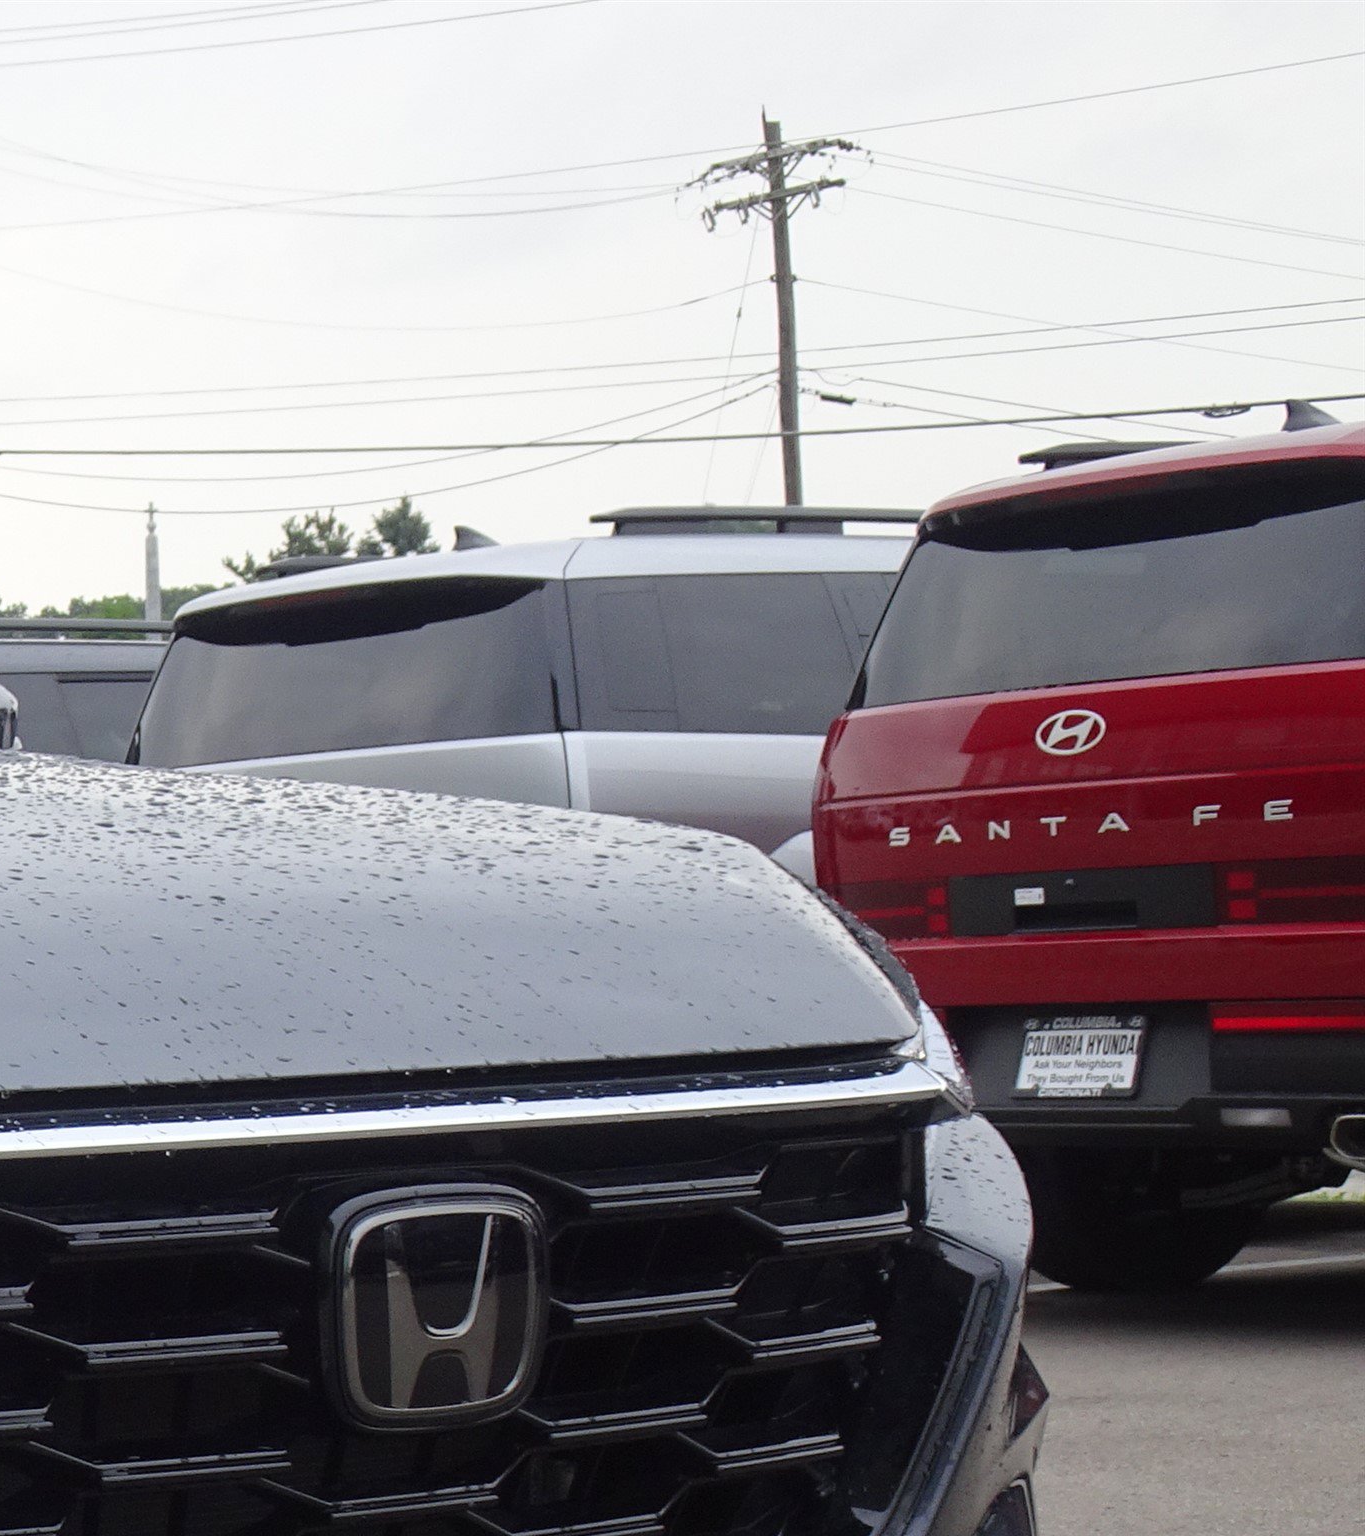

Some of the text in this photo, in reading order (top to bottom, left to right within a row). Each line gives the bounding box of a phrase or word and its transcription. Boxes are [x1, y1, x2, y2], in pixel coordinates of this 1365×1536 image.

[888, 799, 1294, 847] SANTA FE
[1052, 1015, 1116, 1030] COLUMBIA
[1024, 1033, 1137, 1056] COLUMBIA HYUNDA
[1033, 1059, 1123, 1071] Ask Your Neighbors
[1027, 1073, 1125, 1086] They Bought From Us
